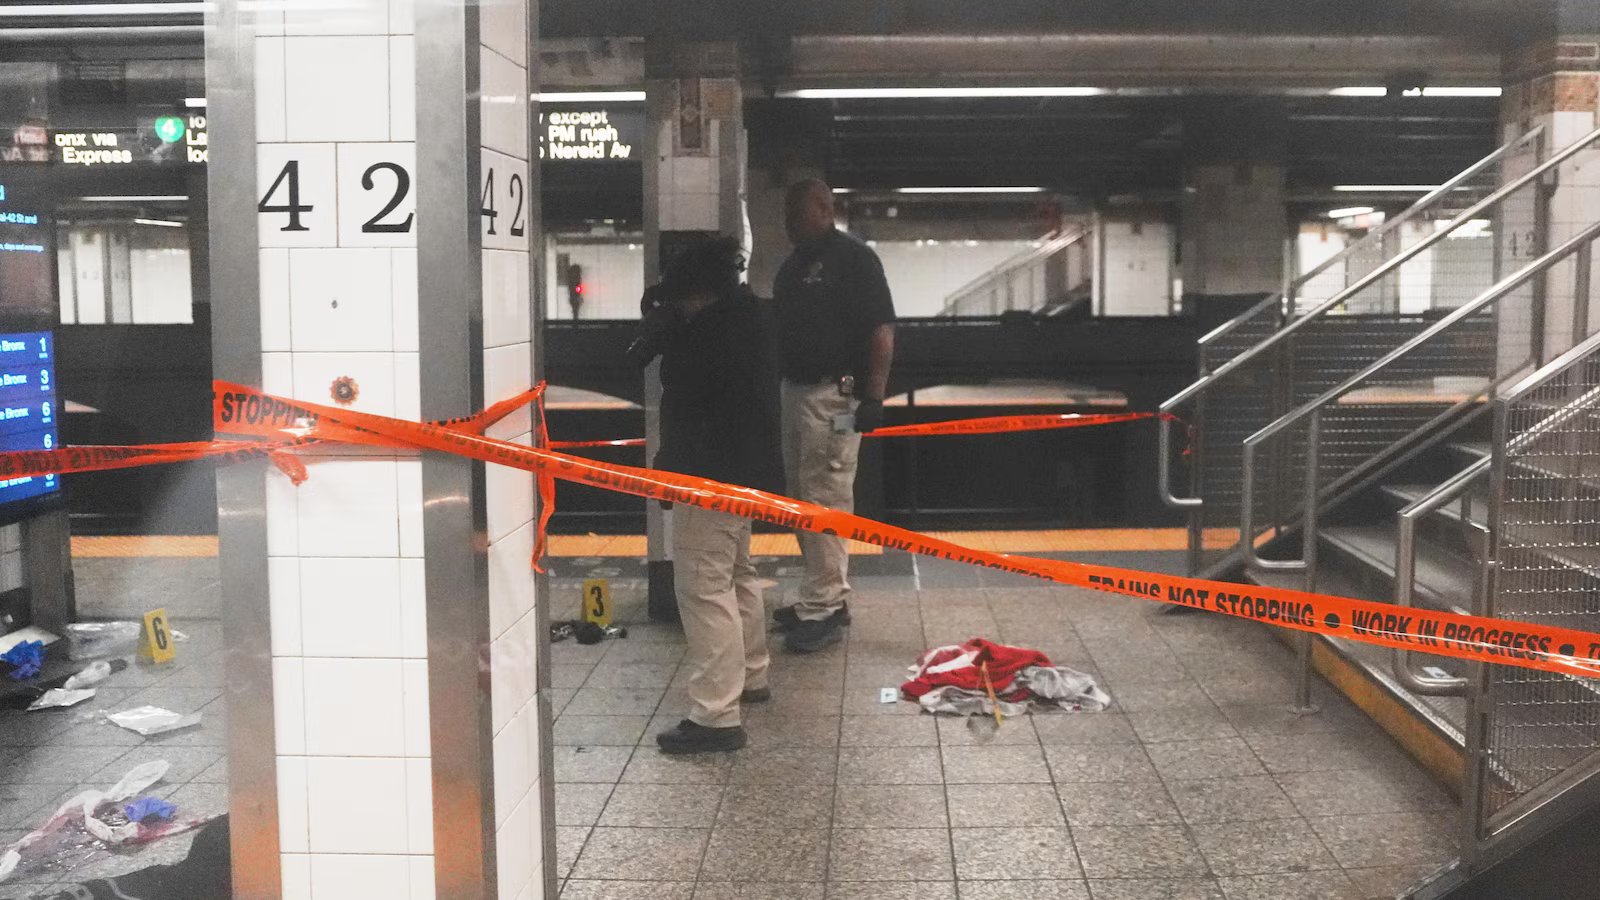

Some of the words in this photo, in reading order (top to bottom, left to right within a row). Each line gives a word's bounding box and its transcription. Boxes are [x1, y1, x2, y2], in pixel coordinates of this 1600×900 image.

[549, 109, 608, 127] except
[91, 133, 118, 146] via
[548, 125, 575, 142] PM
[580, 125, 618, 142] rush
[62, 147, 132, 166] Express
[549, 142, 605, 159] Nereid
[609, 142, 632, 158] Av
[2, 340, 26, 351] Bronx
[39, 337, 47, 352] 1
[3, 374, 27, 385] Bronx
[40, 369, 49, 384] 3
[5, 407, 29, 419] Bronx
[42, 401, 51, 417] 6
[43, 434, 52, 449] 6
[591, 586, 604, 617] 3
[1168, 586, 1209, 609] NOT
[1215, 592, 1315, 627] STOPPING
[1352, 609, 1413, 643] WORK
[1418, 618, 1440, 646] IN
[1443, 622, 1552, 661] PROGRESS
[152, 617, 168, 650] 6
